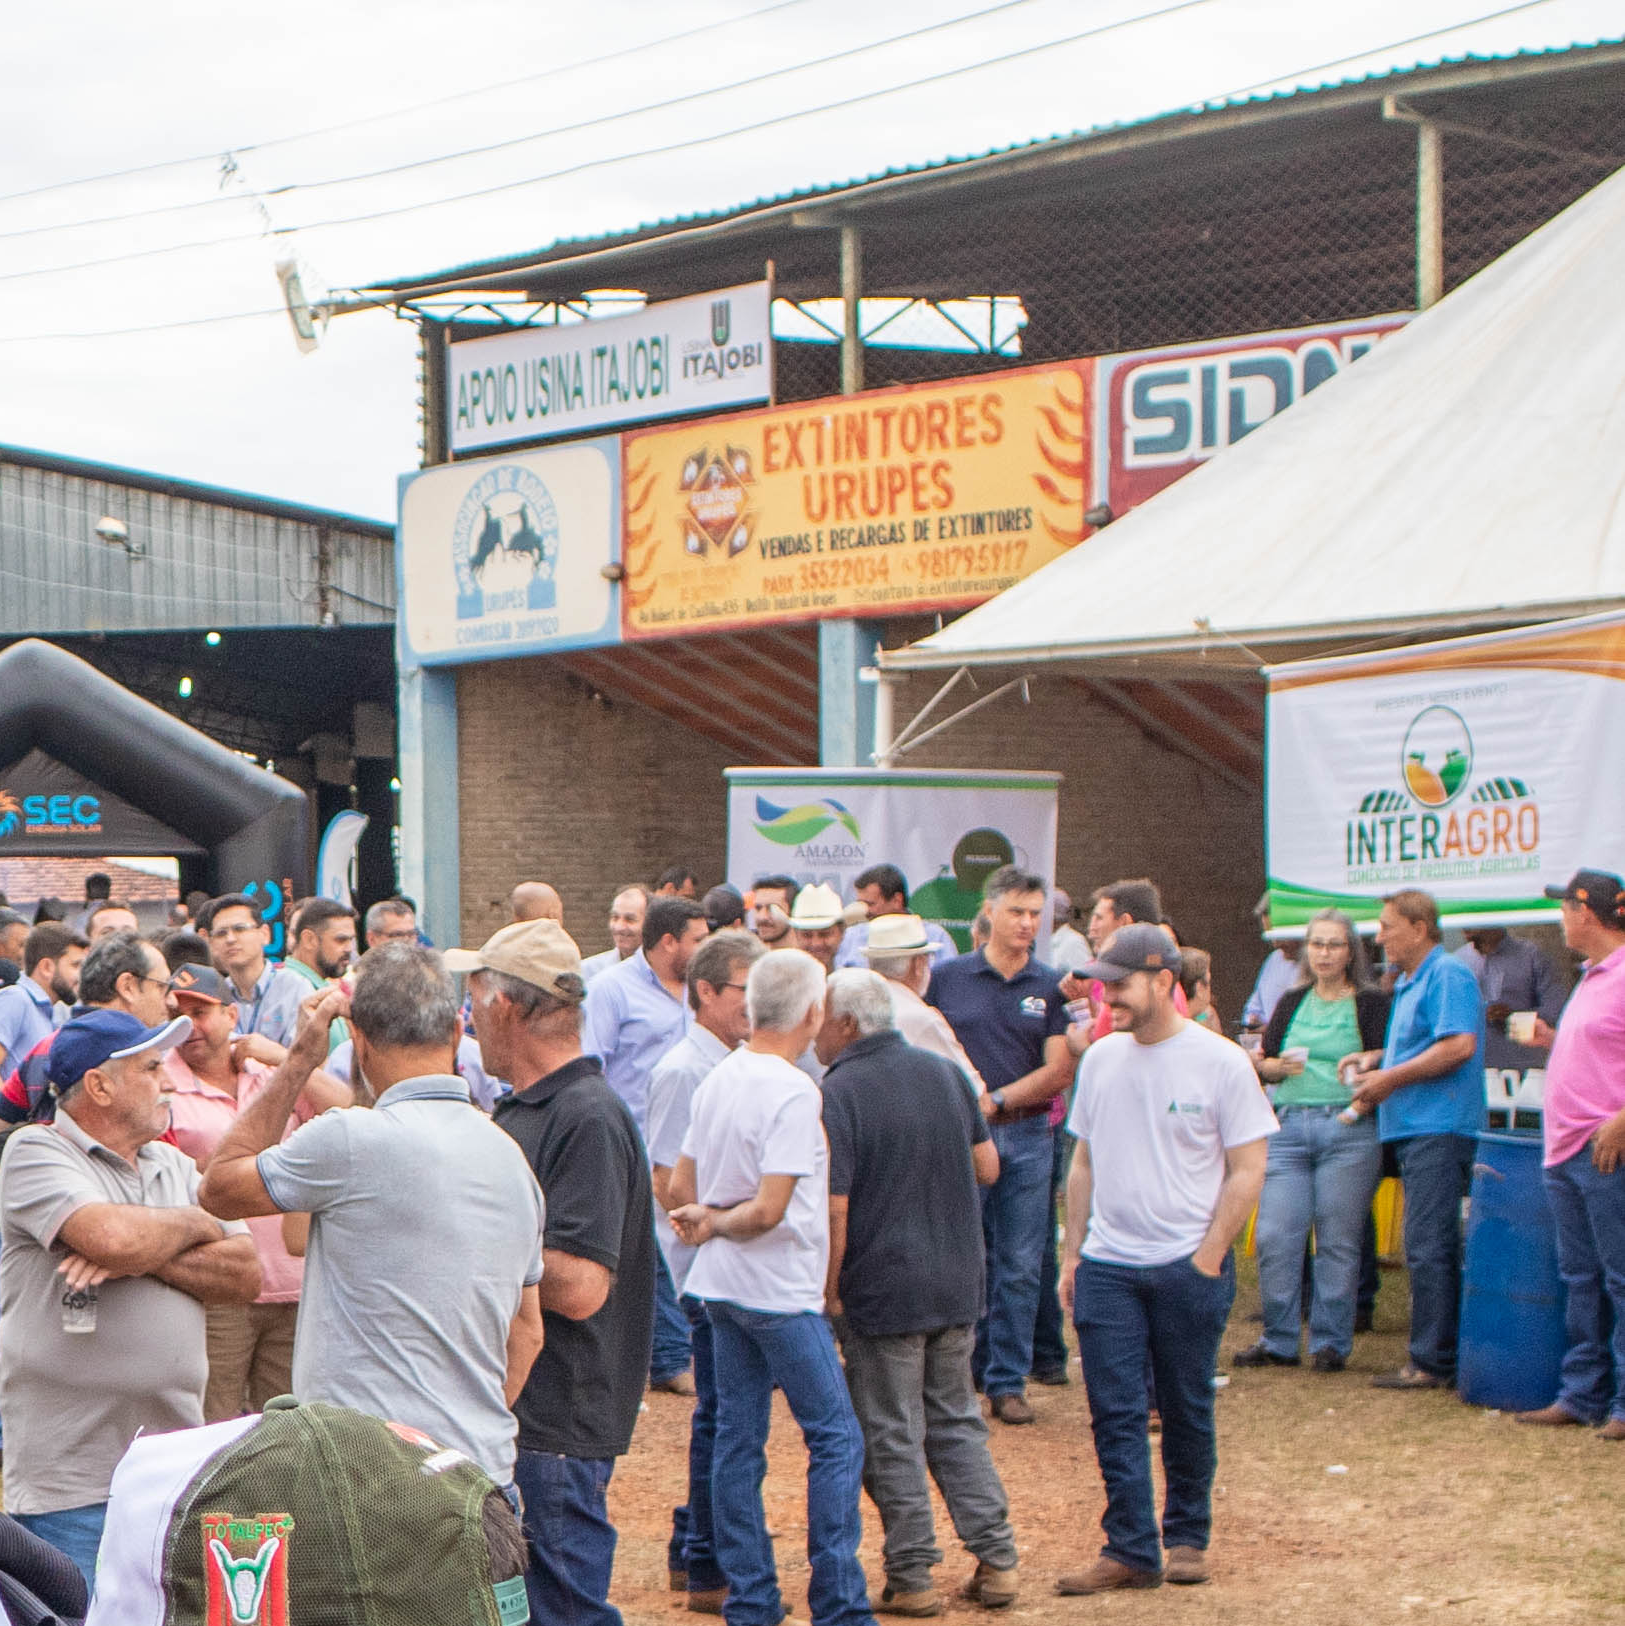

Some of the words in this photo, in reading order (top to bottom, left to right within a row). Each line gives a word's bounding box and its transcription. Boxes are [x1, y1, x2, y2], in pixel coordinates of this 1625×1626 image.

[682, 342, 763, 380] ITAJOBI
[457, 362, 518, 431] APOIO
[524, 350, 586, 420] USINA
[591, 334, 670, 407] ITAJOBI
[762, 393, 1004, 474] EXTINTORES
[803, 462, 955, 523] URUPES
[759, 534, 812, 560] VENDAS
[816, 531, 824, 552] E
[830, 521, 906, 551] RECARGAS
[914, 518, 931, 541] DE
[938, 507, 1034, 540] EXTINTORES
[1464, 682, 1509, 699] EVENTO
[23, 794, 101, 826] SEC
[794, 844, 865, 859] AMAZON
[1346, 802, 1540, 866] INTERAGRO
[1402, 865, 1417, 880] DE
[1419, 860, 1475, 880] PRODUTOS
[204, 1521, 287, 1541] TOTALPEC
